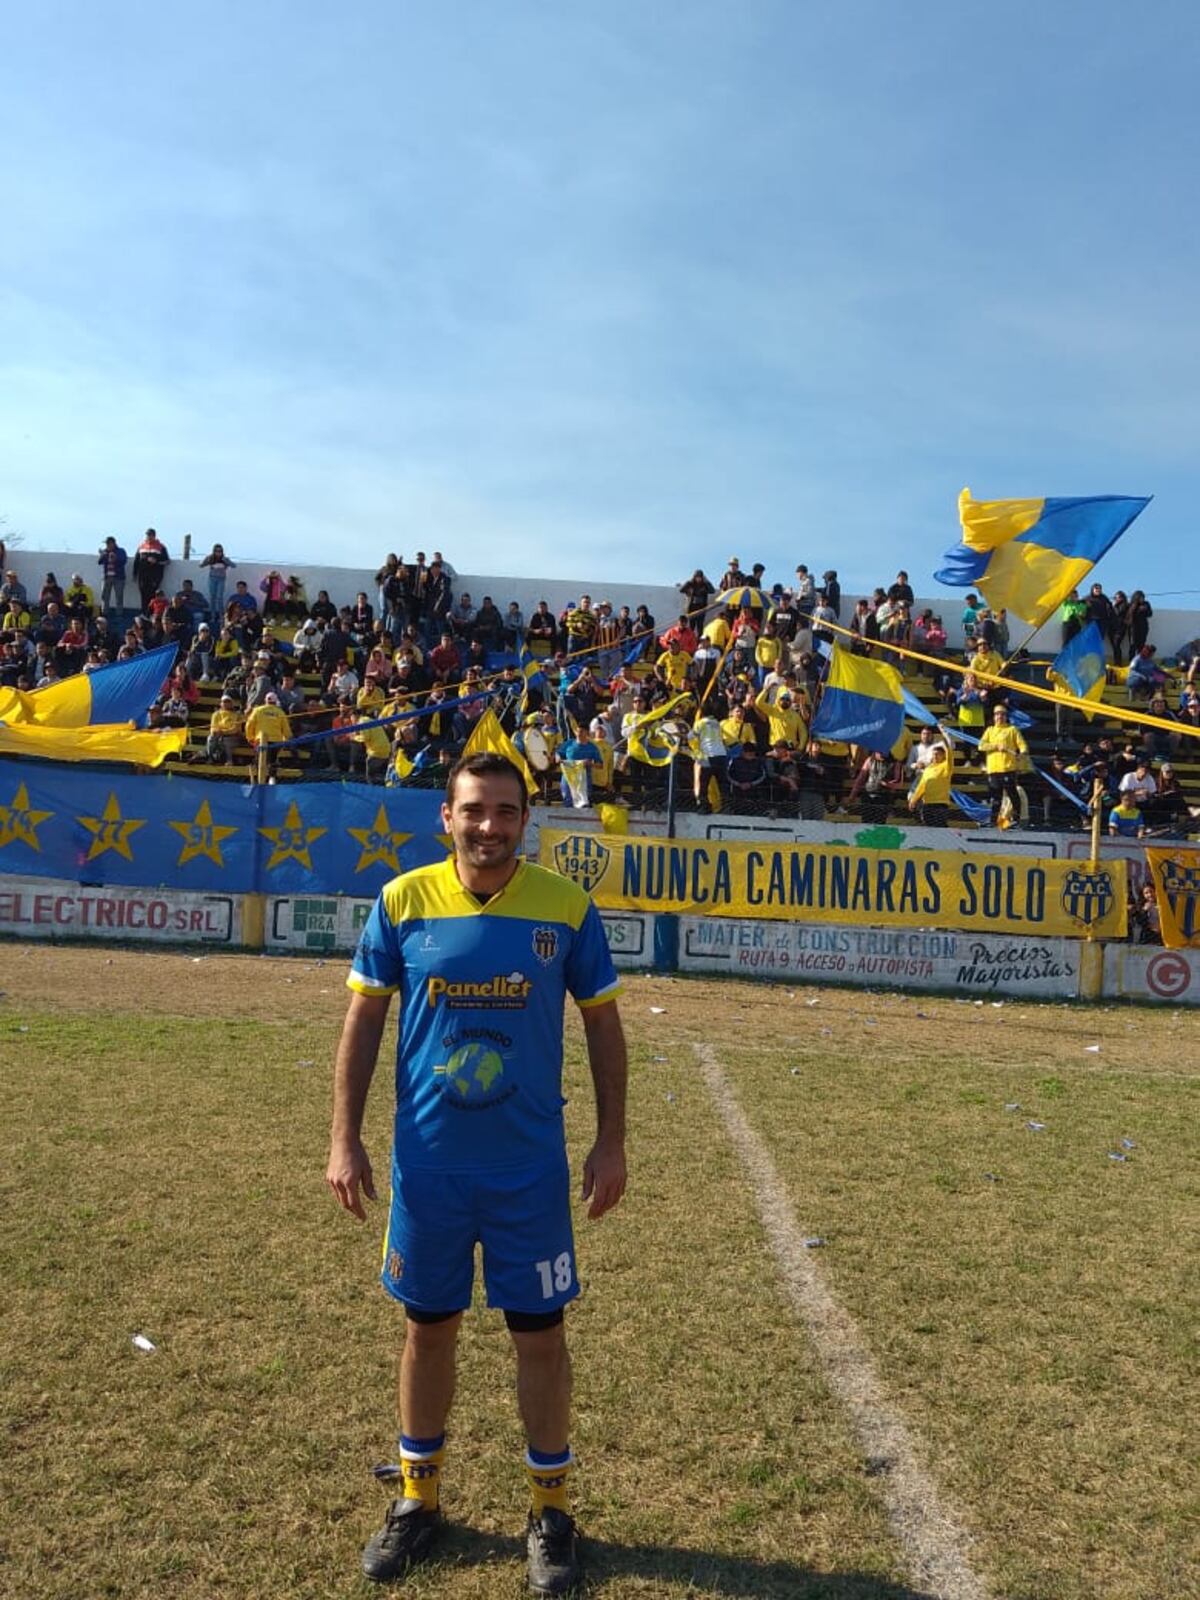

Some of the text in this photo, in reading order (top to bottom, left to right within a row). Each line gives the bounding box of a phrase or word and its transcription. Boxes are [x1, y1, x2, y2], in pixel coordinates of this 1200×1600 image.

[564, 857, 599, 876] 1943
[622, 843, 1046, 923] NUNCA CAMINARAS SOLO
[797, 928, 958, 959] CONSTRUCCION
[969, 941, 1053, 966] Precios
[738, 951, 775, 968] RUTA
[796, 953, 846, 972] ACCESO
[857, 956, 934, 978] AUTOPISTA
[956, 960, 1076, 987] Mayoristas
[535, 1251, 572, 1299] 18
